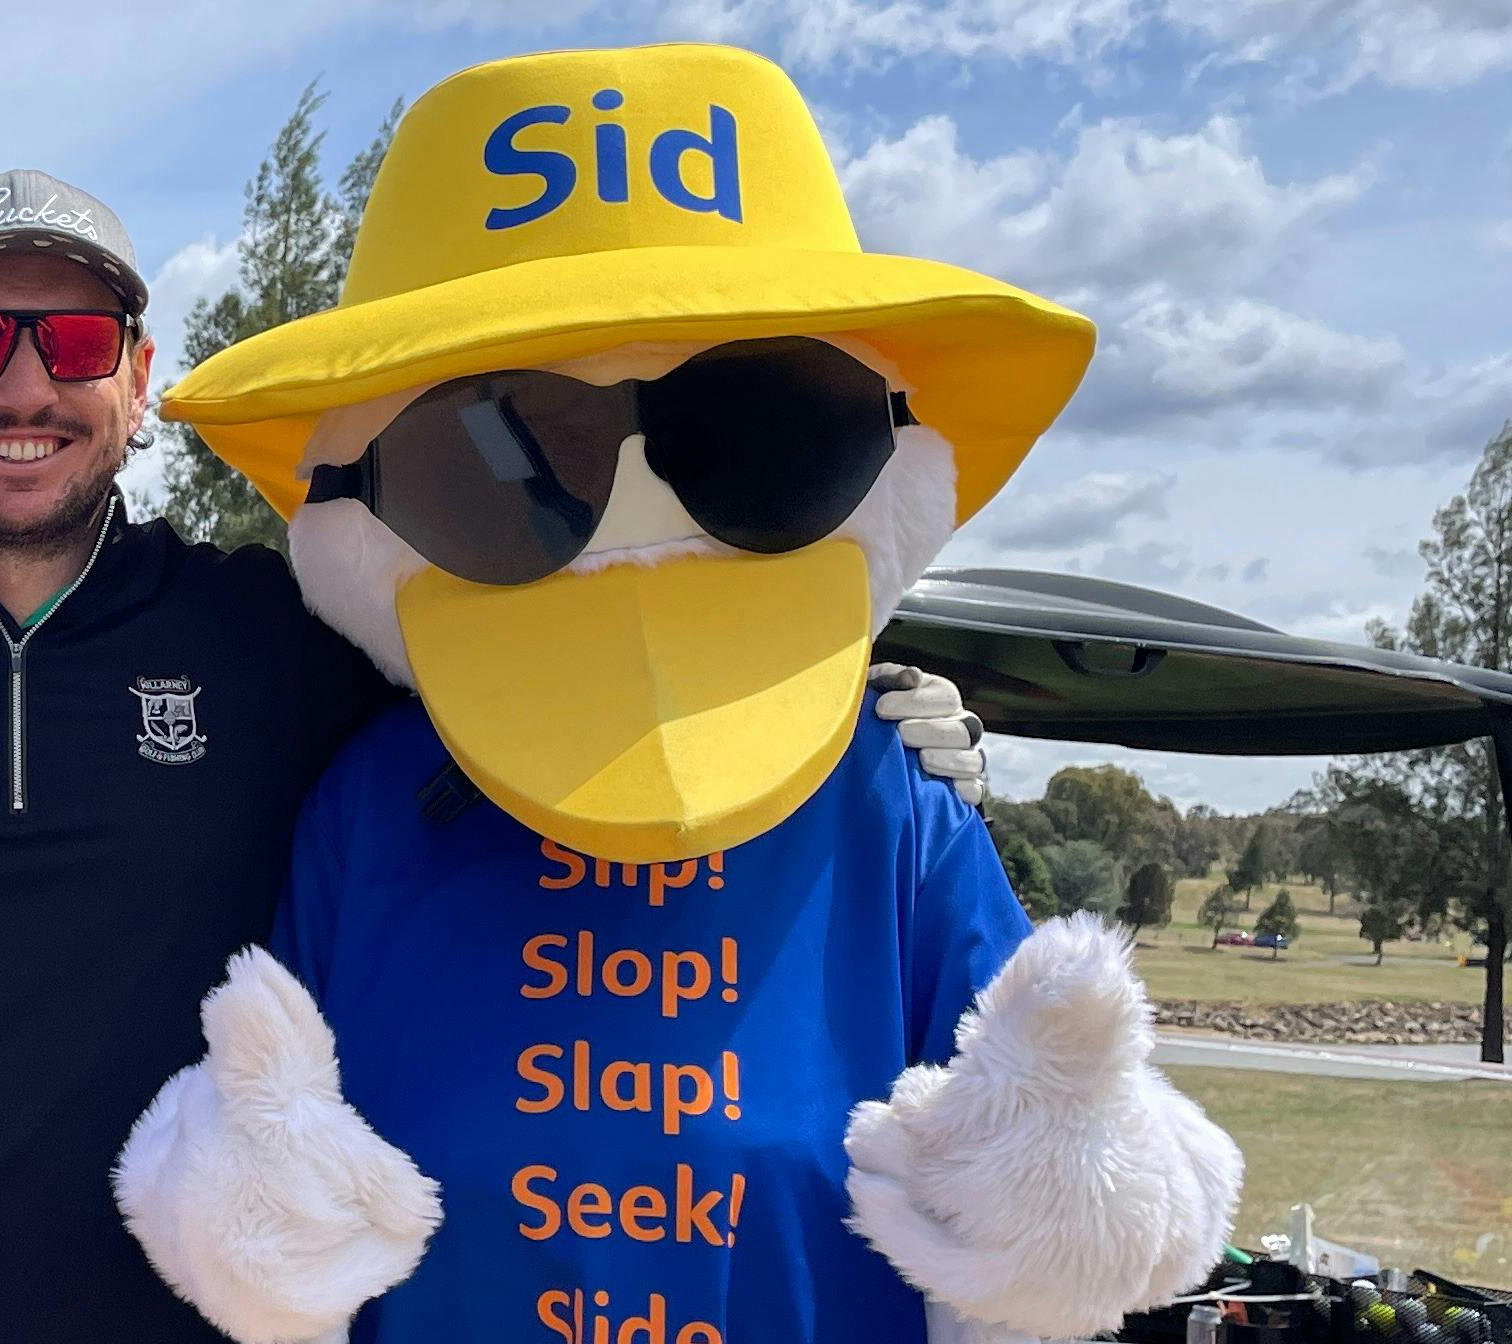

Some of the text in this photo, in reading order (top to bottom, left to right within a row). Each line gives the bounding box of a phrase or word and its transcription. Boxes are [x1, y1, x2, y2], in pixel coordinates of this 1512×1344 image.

[484, 88, 743, 230] Sid
[519, 930, 738, 1018] Slop!
[515, 1040, 741, 1135] Slap!
[511, 1163, 746, 1248] Seek!
